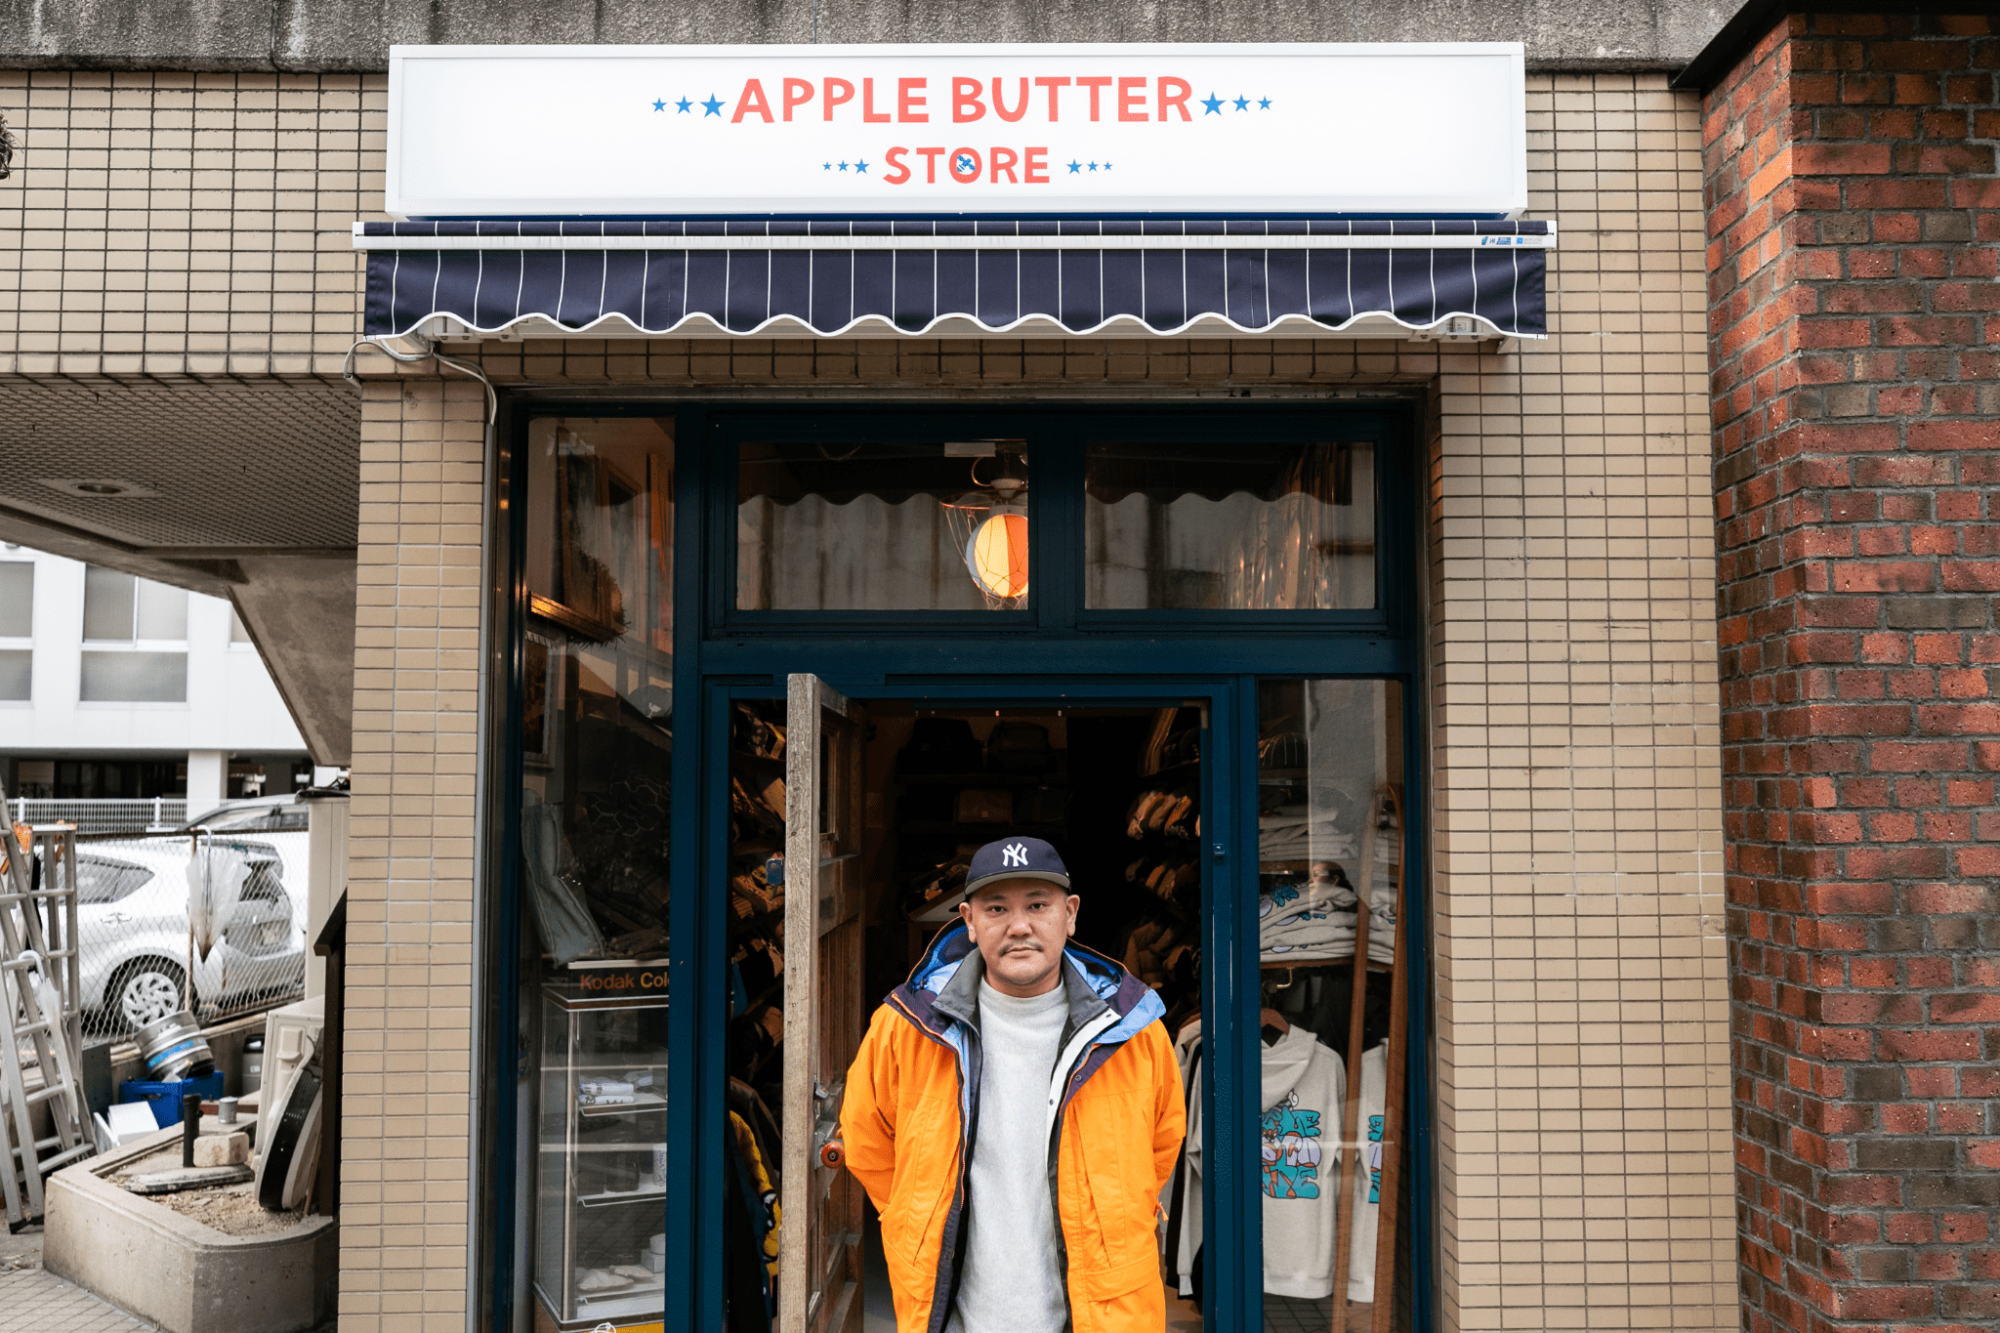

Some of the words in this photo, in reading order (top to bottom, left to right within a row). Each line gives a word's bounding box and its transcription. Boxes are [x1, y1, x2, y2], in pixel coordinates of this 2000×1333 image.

[730, 76, 930, 124] APPLE
[951, 75, 1193, 124] BUTTER
[882, 146, 1050, 185] STORE
[1002, 843, 1029, 867] NY
[580, 973, 635, 990] Kodak
[640, 971, 669, 988] Col
